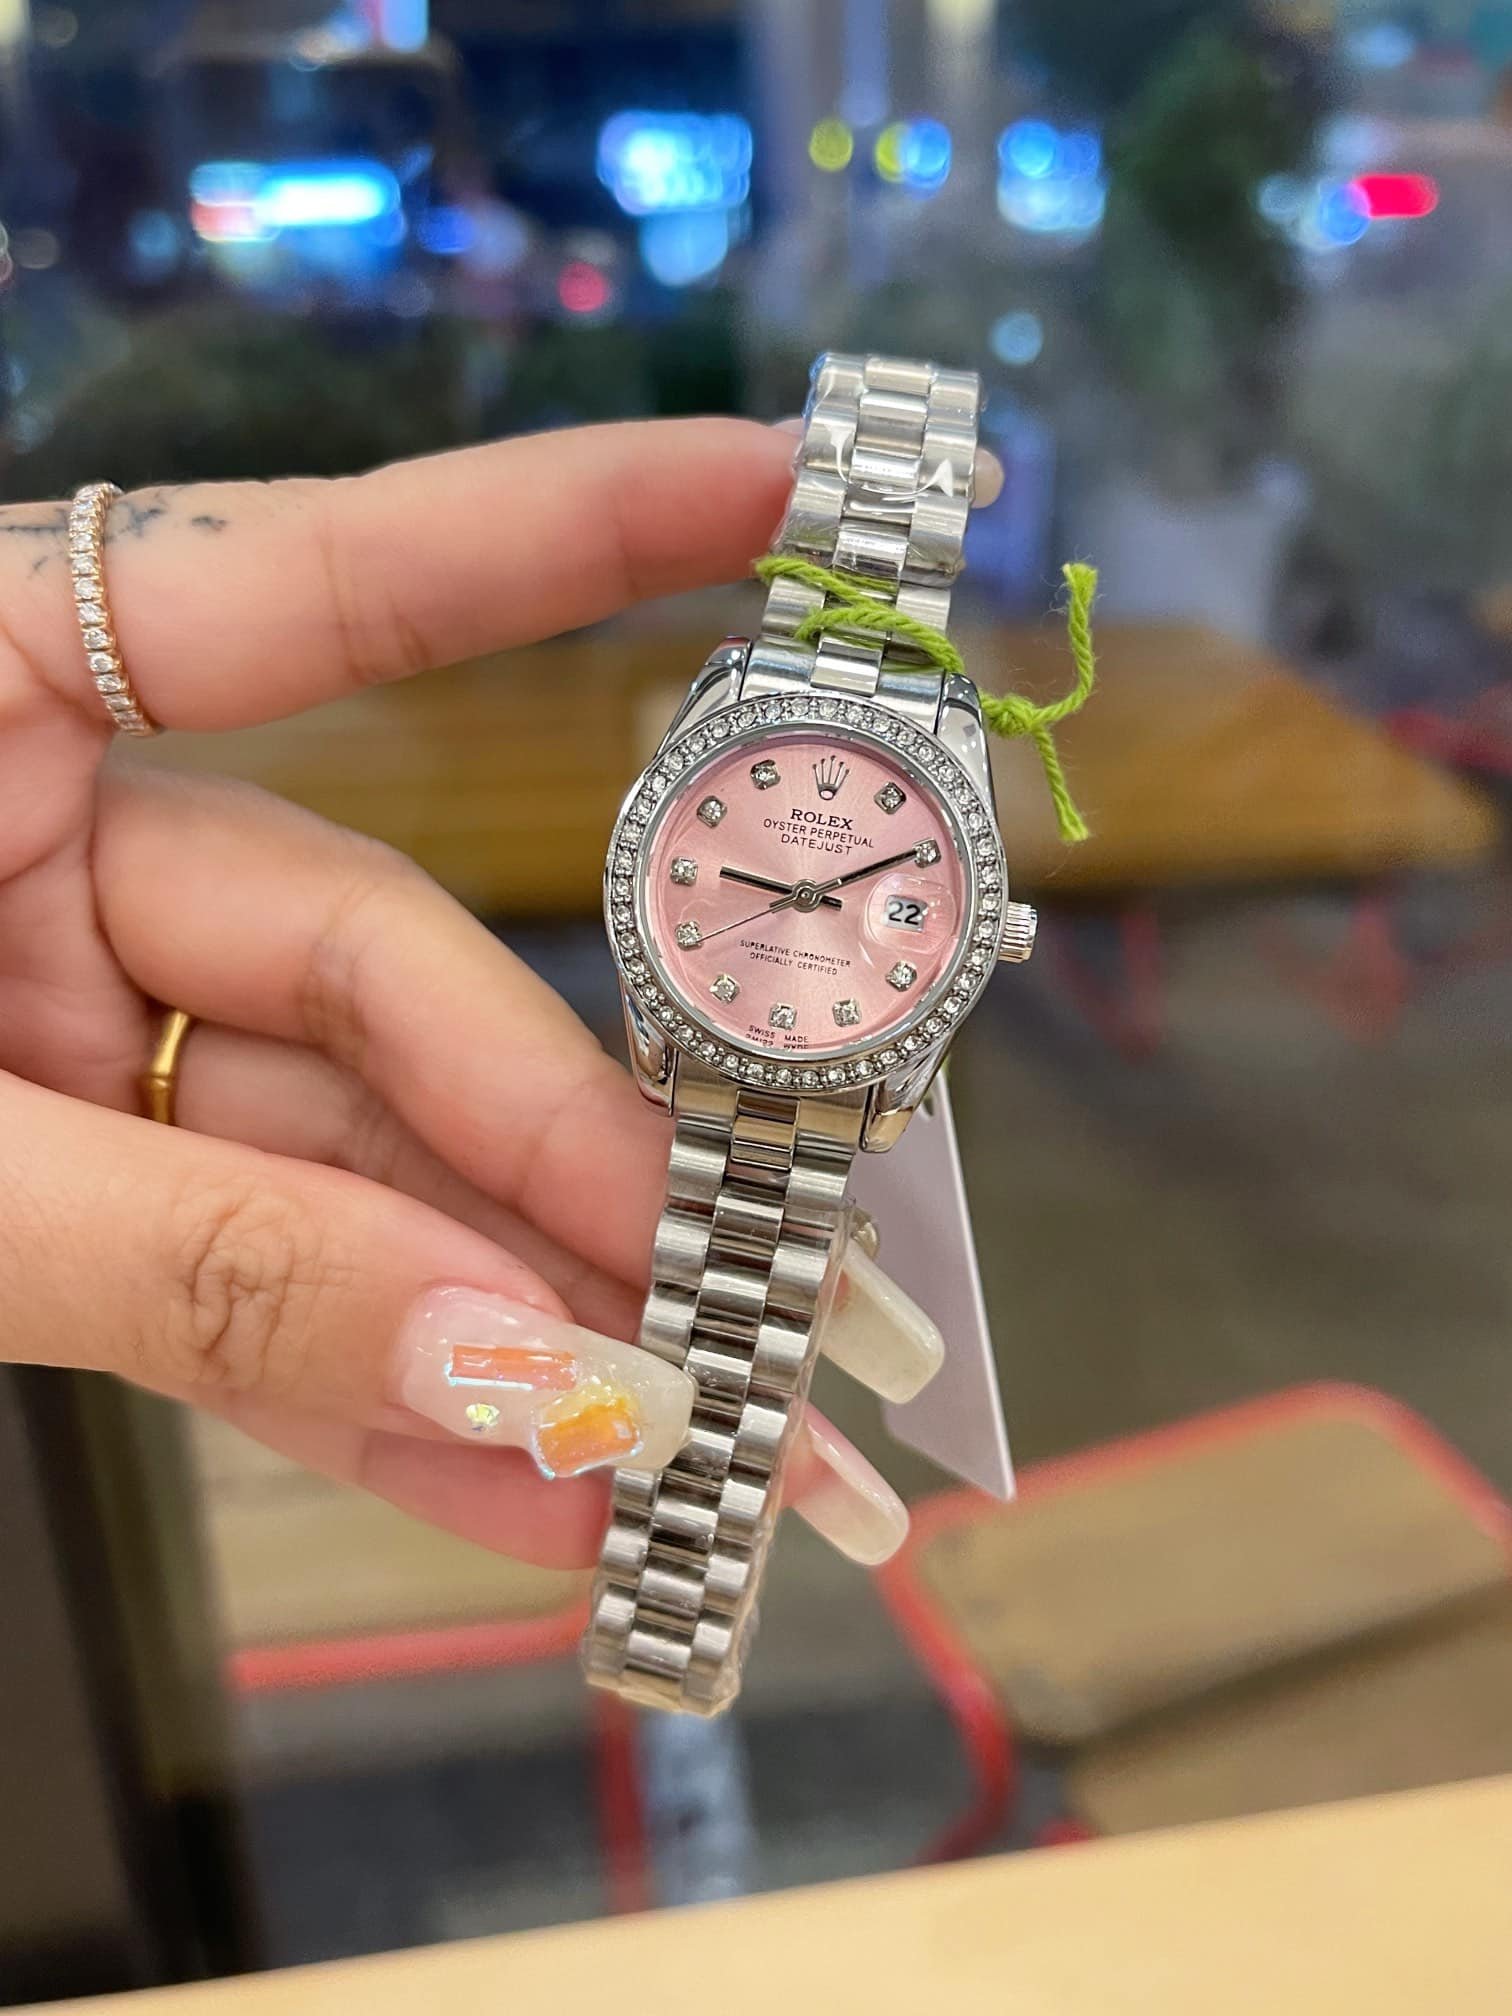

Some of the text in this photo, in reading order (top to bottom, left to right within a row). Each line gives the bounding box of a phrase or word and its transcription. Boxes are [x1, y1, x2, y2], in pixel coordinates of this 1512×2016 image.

[790, 808, 854, 831] ROLEX
[763, 818, 875, 848] OYSTER PERPETUAL
[781, 833, 853, 855] DATEJUST
[888, 900, 921, 925] 22
[740, 939, 851, 967] SUPERLATIVE CHRONOMETER
[749, 952, 838, 975] OFFICIALLY CERTIFIED
[748, 1024, 776, 1039] SWISS
[784, 1034, 809, 1043] MADE
